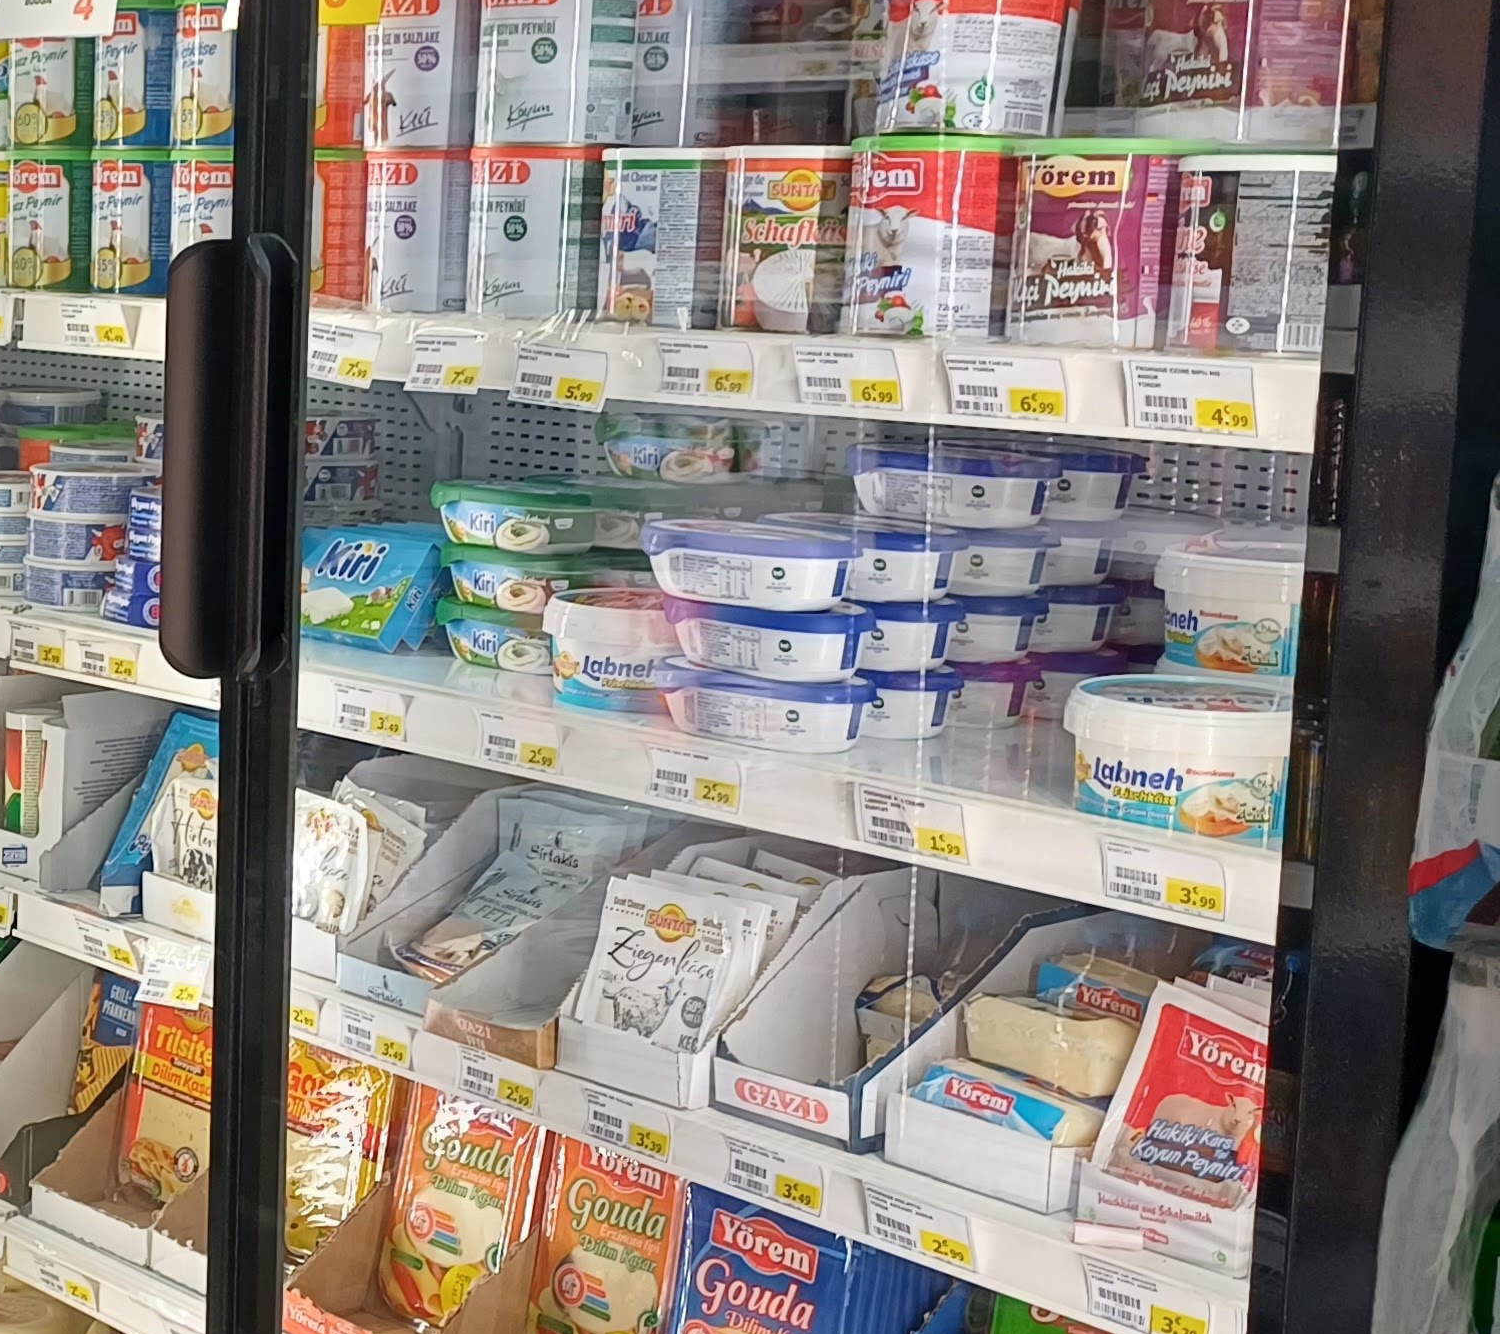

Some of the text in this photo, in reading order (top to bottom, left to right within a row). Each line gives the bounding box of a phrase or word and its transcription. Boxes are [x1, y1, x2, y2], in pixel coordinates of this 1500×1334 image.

[1166, 65, 1232, 93] Peyniri
[1027, 165, 1117, 186] Yörem
[469, 510, 496, 533] Kiri
[315, 537, 392, 582] Kiri
[472, 571, 498, 594] Kiri
[404, 585, 423, 612] Kiri
[472, 630, 498, 653] Kiri
[1093, 756, 1184, 792] Labneh
[526, 844, 579, 868] Sirtakis
[473, 905, 518, 928] FETA
[648, 914, 693, 935] SUNTAT
[607, 926, 715, 981] Ziegenkäse
[1080, 984, 1139, 1019] Yörem
[151, 1062, 181, 1086] Dilim
[949, 1076, 1013, 1115] Yörem
[1199, 1128, 1234, 1150] Kars
[1131, 1139, 1246, 1180] Koyun Peyniri
[567, 1178, 667, 1240] Gouda
[579, 1232, 618, 1262] Dilim
[718, 1217, 812, 1278] Yörem
[694, 1257, 816, 1330] Gouda
